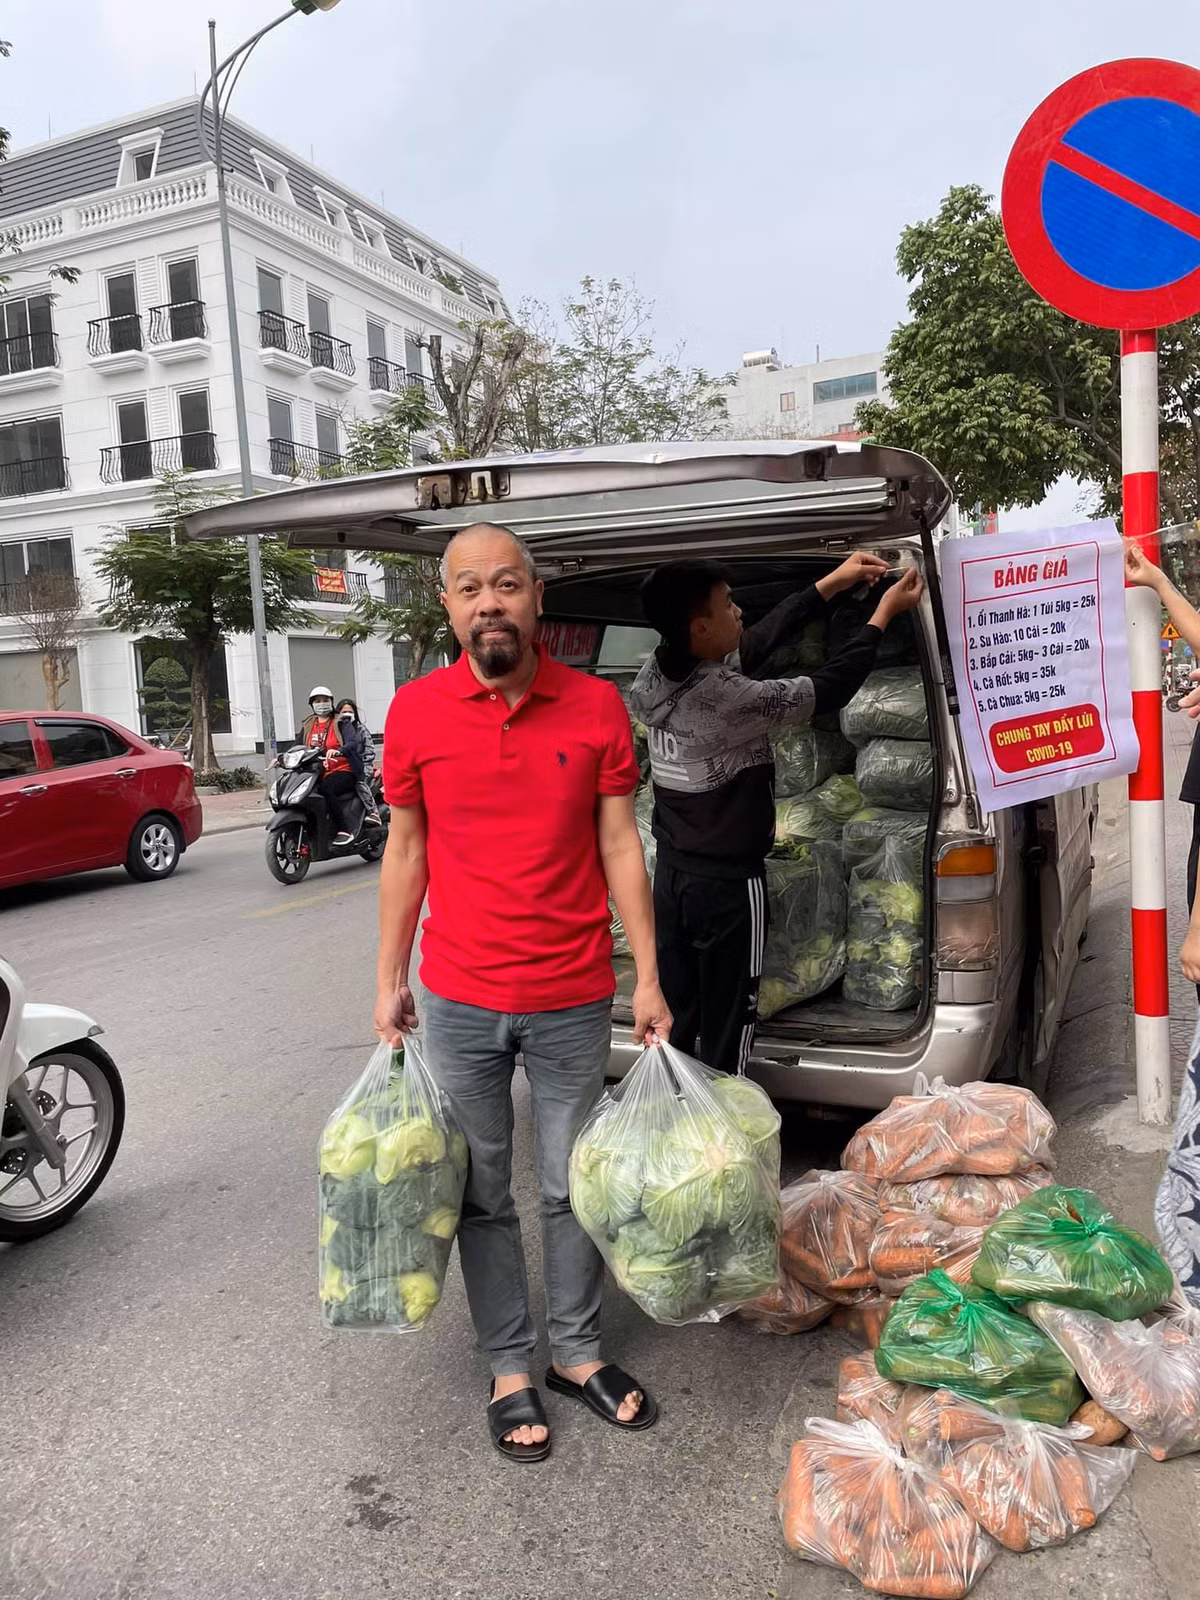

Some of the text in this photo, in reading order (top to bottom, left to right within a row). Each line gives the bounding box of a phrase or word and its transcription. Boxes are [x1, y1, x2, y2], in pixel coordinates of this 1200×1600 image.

[994, 555, 1068, 589] BẢNG GIÁ
[968, 616, 976, 628] 1.
[977, 608, 987, 627] Ổi
[989, 608, 1015, 624] Thanh
[1016, 606, 1031, 620] Hà:
[1033, 605, 1037, 617] 1
[1041, 602, 1054, 616] Túi
[1055, 600, 1071, 614] 5kg
[1080, 594, 1096, 609] 25k
[969, 620, 1066, 650] 2. Su Hào: 10 Cái = 20k
[969, 658, 979, 671] 3.
[980, 652, 997, 669] Bắp
[1042, 645, 1048, 658] 3
[1065, 644, 1072, 652] =
[1073, 637, 1090, 652] 20k
[973, 679, 982, 692] 4.
[995, 671, 1013, 688] Rốt:
[1013, 670, 1030, 684] 5kg
[1031, 671, 1038, 679] =
[1040, 664, 1056, 679] 35k
[977, 700, 987, 713] 5.
[999, 693, 1024, 708] Chua:
[1024, 690, 1040, 704] 5kg
[1041, 690, 1048, 699] =
[1049, 684, 1066, 699] 25k
[995, 725, 1032, 747] CHUNG
[1032, 721, 1052, 739] TAY
[1052, 713, 1075, 735] ĐẨY
[1026, 740, 1074, 764] COVID-19
